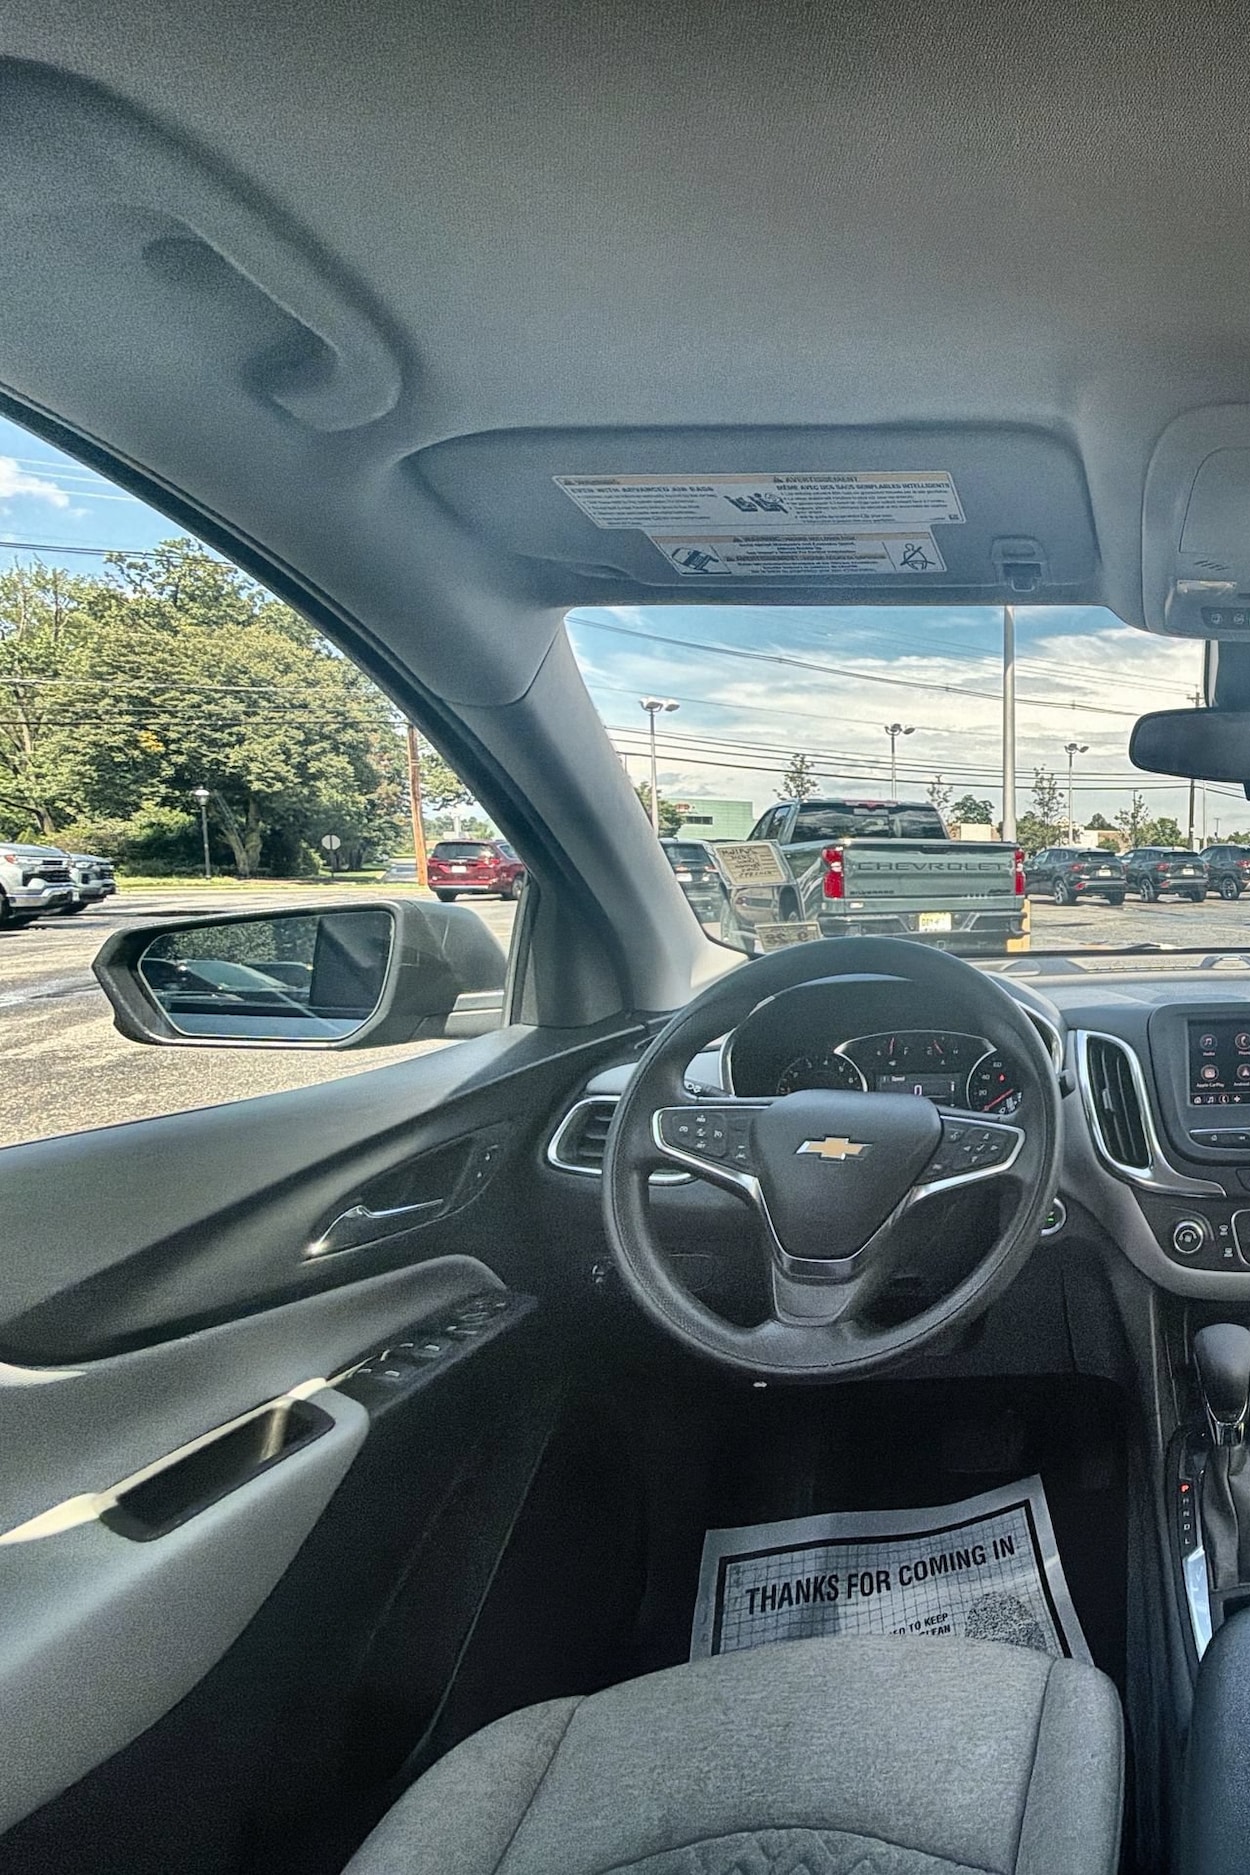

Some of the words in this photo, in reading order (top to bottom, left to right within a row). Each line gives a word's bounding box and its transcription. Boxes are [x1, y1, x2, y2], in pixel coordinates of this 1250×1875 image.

[857, 861, 1007, 871] CHEVROLET
[745, 1573, 840, 1616] THANKS
[847, 1569, 892, 1600] FOR
[898, 1544, 987, 1587] COMING
[992, 1534, 1017, 1561] IN
[909, 1620, 922, 1633] TO
[923, 1612, 949, 1627] KEEP
